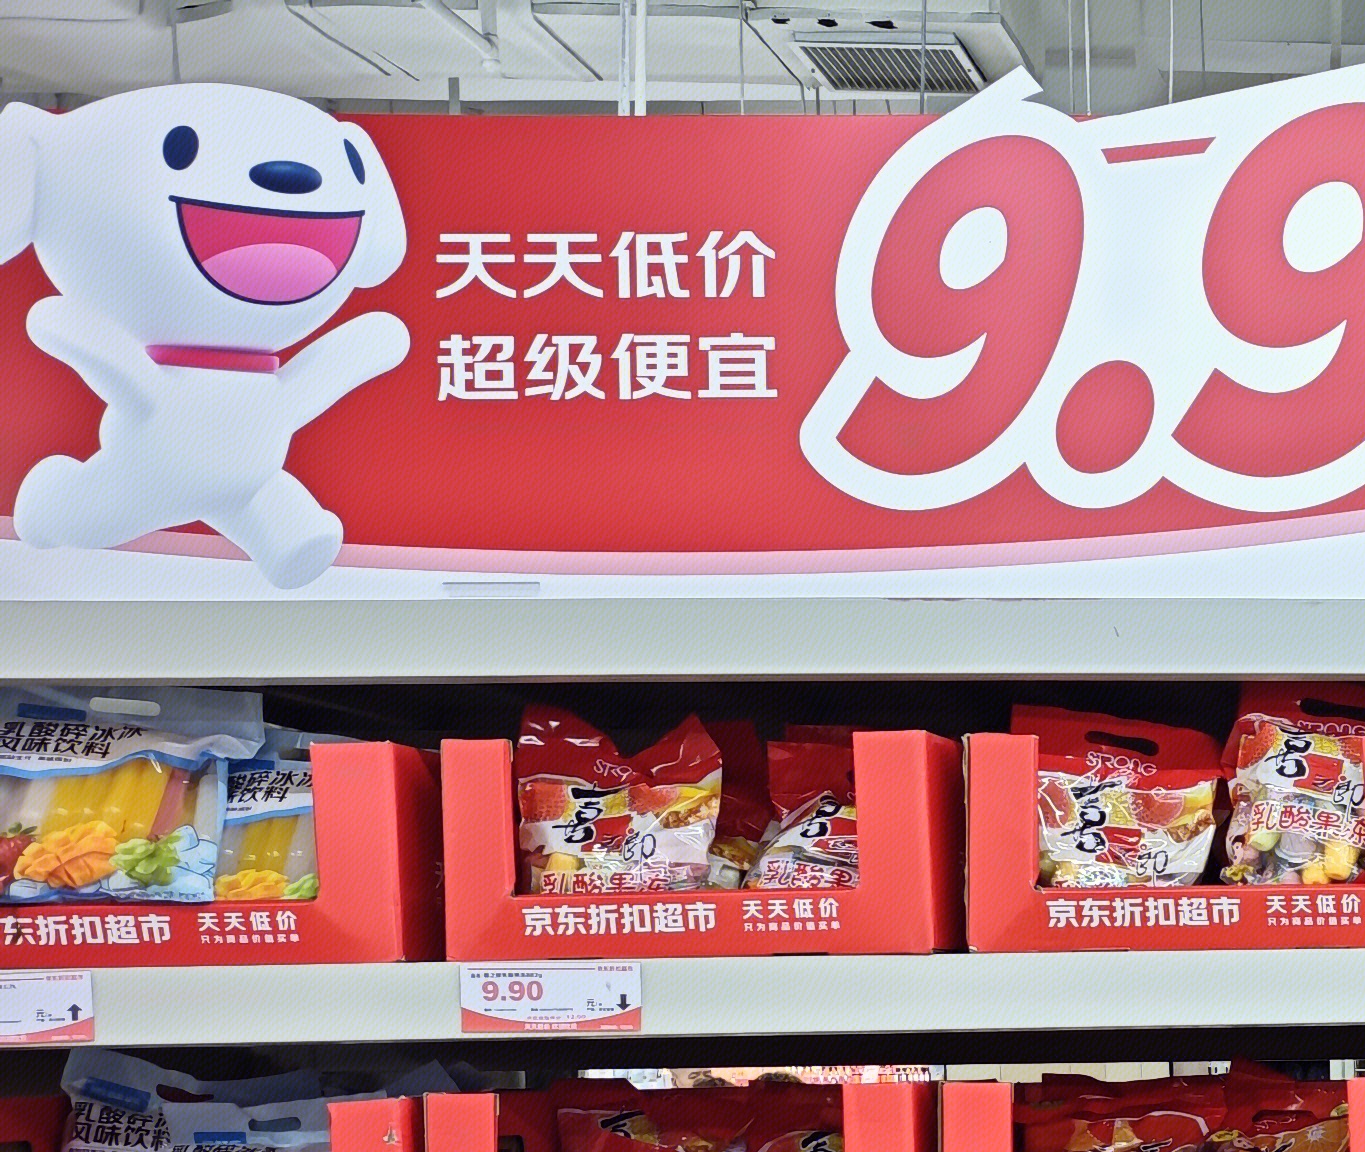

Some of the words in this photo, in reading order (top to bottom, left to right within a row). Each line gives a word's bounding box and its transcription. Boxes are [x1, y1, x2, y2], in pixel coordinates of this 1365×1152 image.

[436, 231, 776, 299] 天天低价
[438, 334, 778, 401] 超级便宜
[742, 899, 840, 920] 天天低价
[1047, 897, 1240, 927] 京东折扣超市
[1267, 894, 1361, 915] 天天低价
[198, 912, 298, 932] 天天低价
[522, 904, 716, 936] 京东折扣超市
[482, 981, 543, 1001] 9.90
